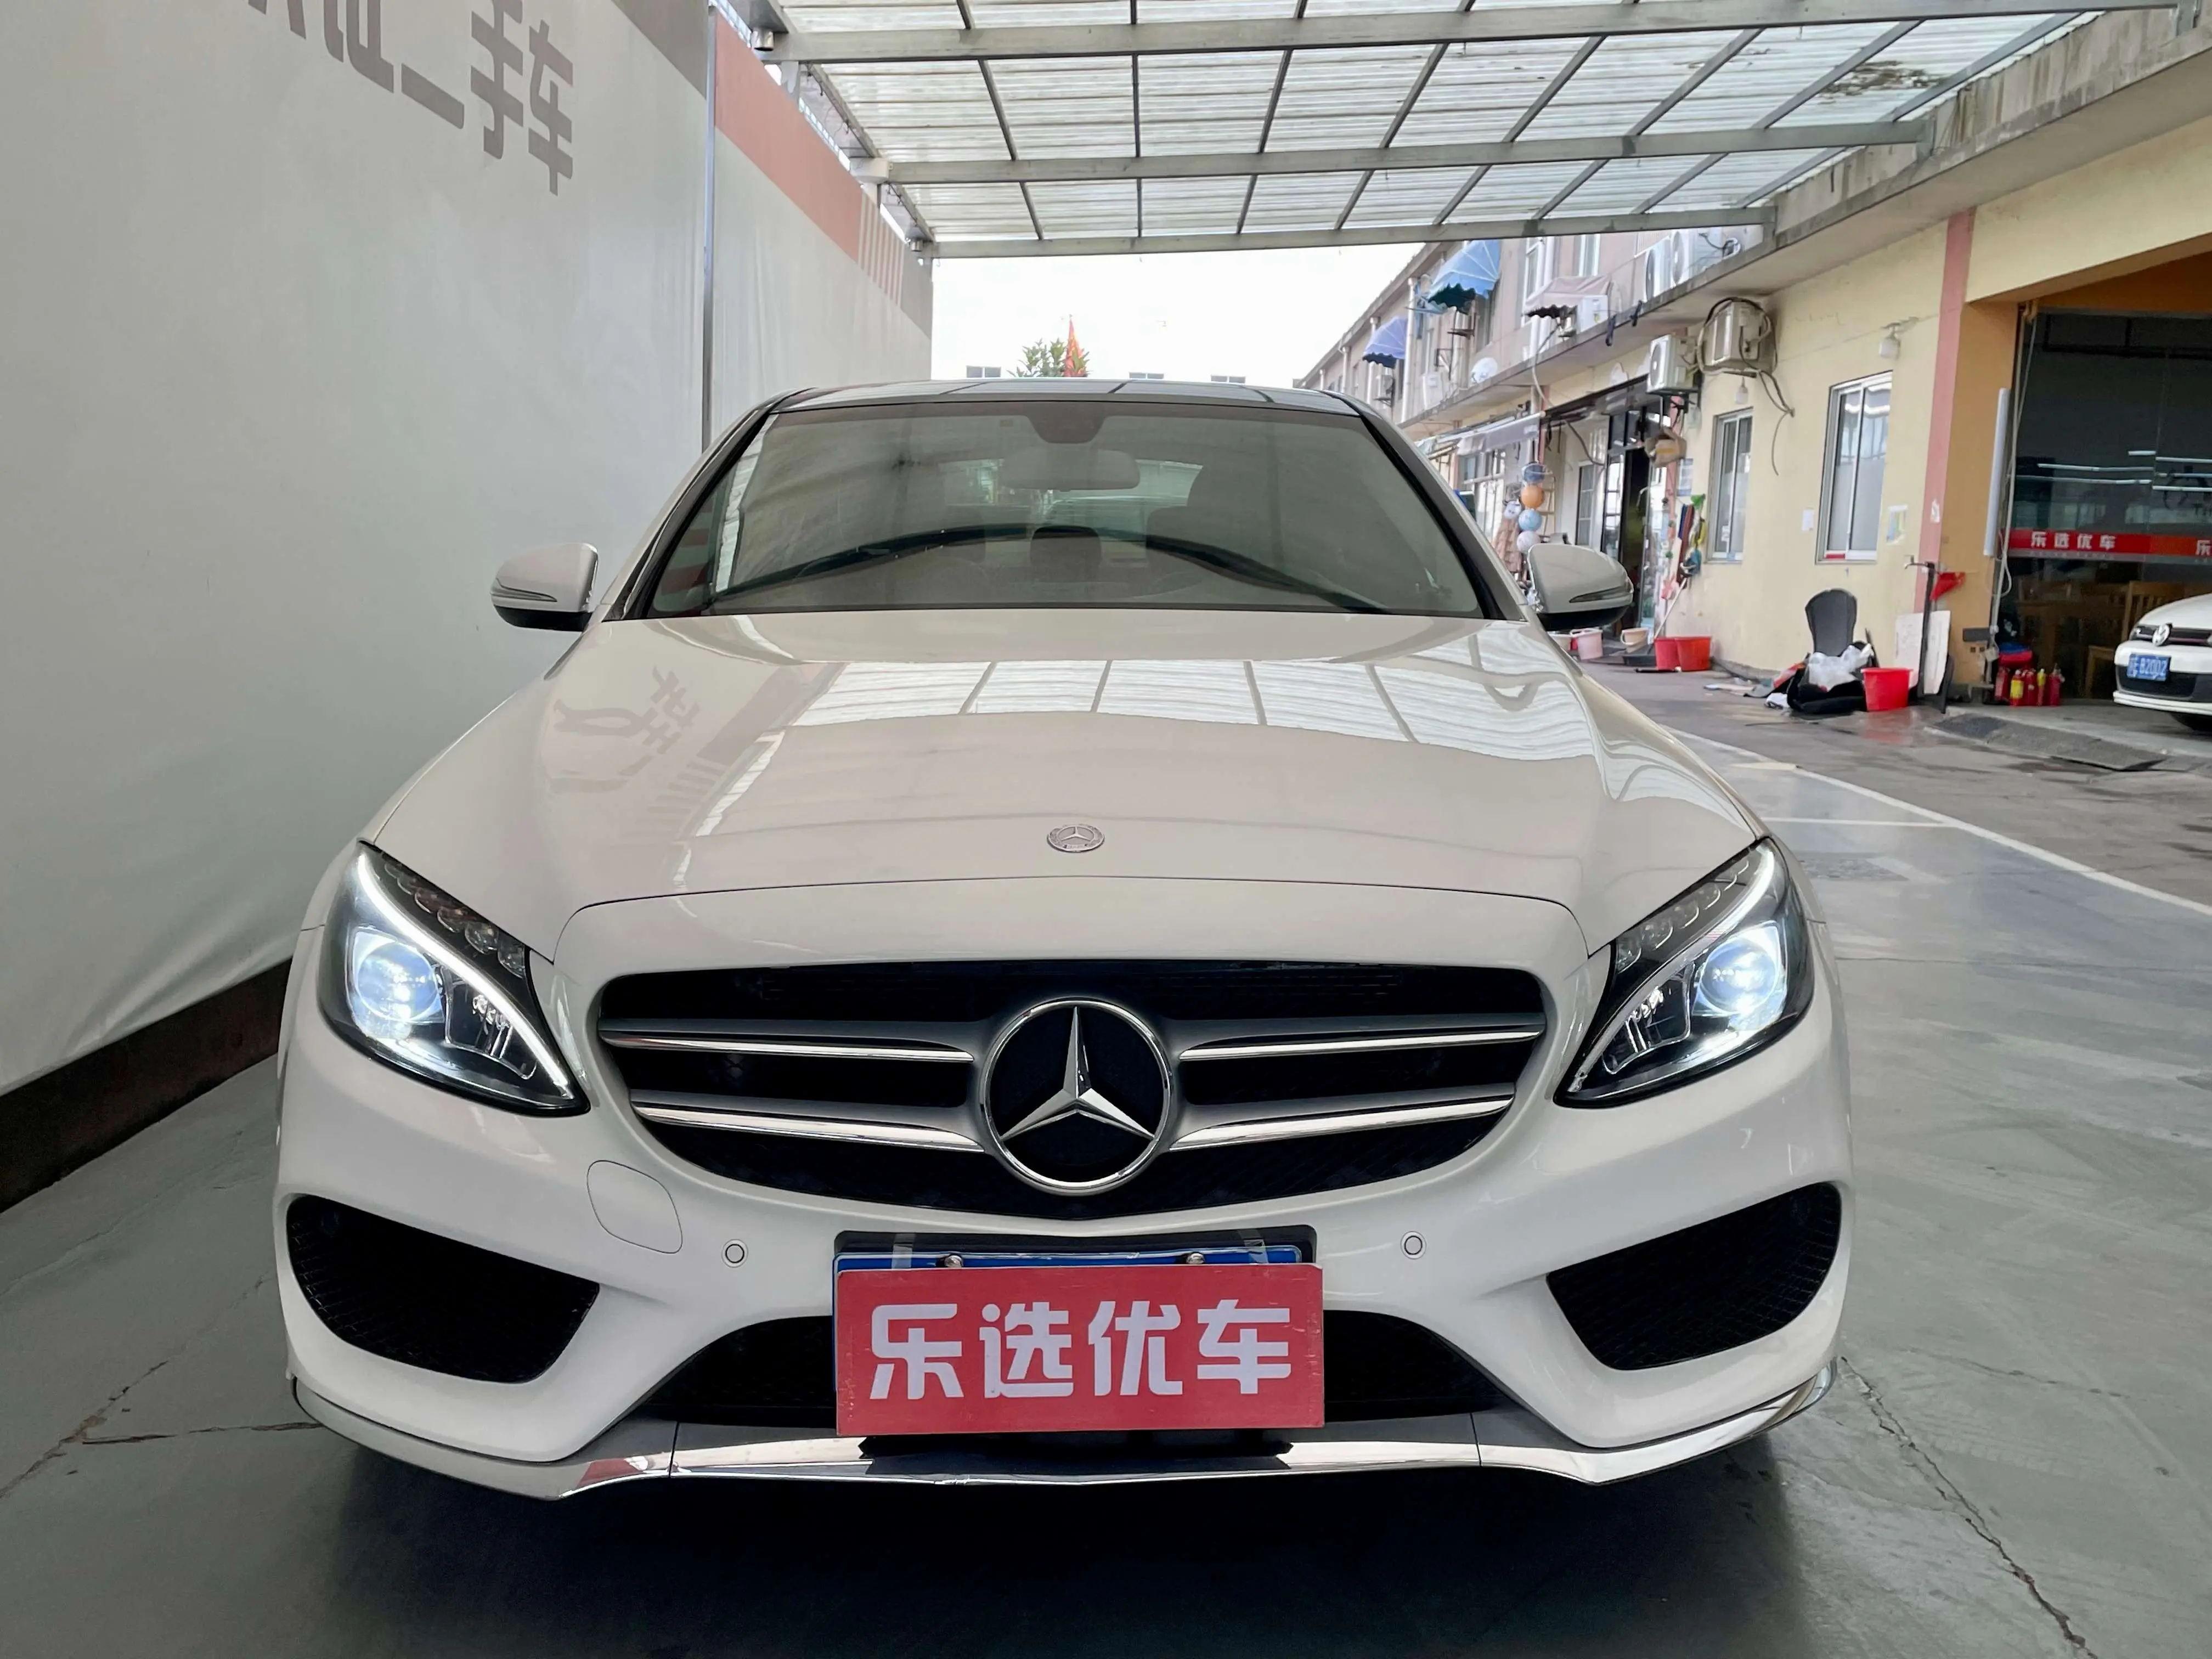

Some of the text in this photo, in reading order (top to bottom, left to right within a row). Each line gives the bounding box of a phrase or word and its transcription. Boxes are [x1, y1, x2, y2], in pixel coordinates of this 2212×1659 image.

[2031, 531, 2116, 550] 乐选优车
[870, 1299, 1291, 1400] 乐选优车
